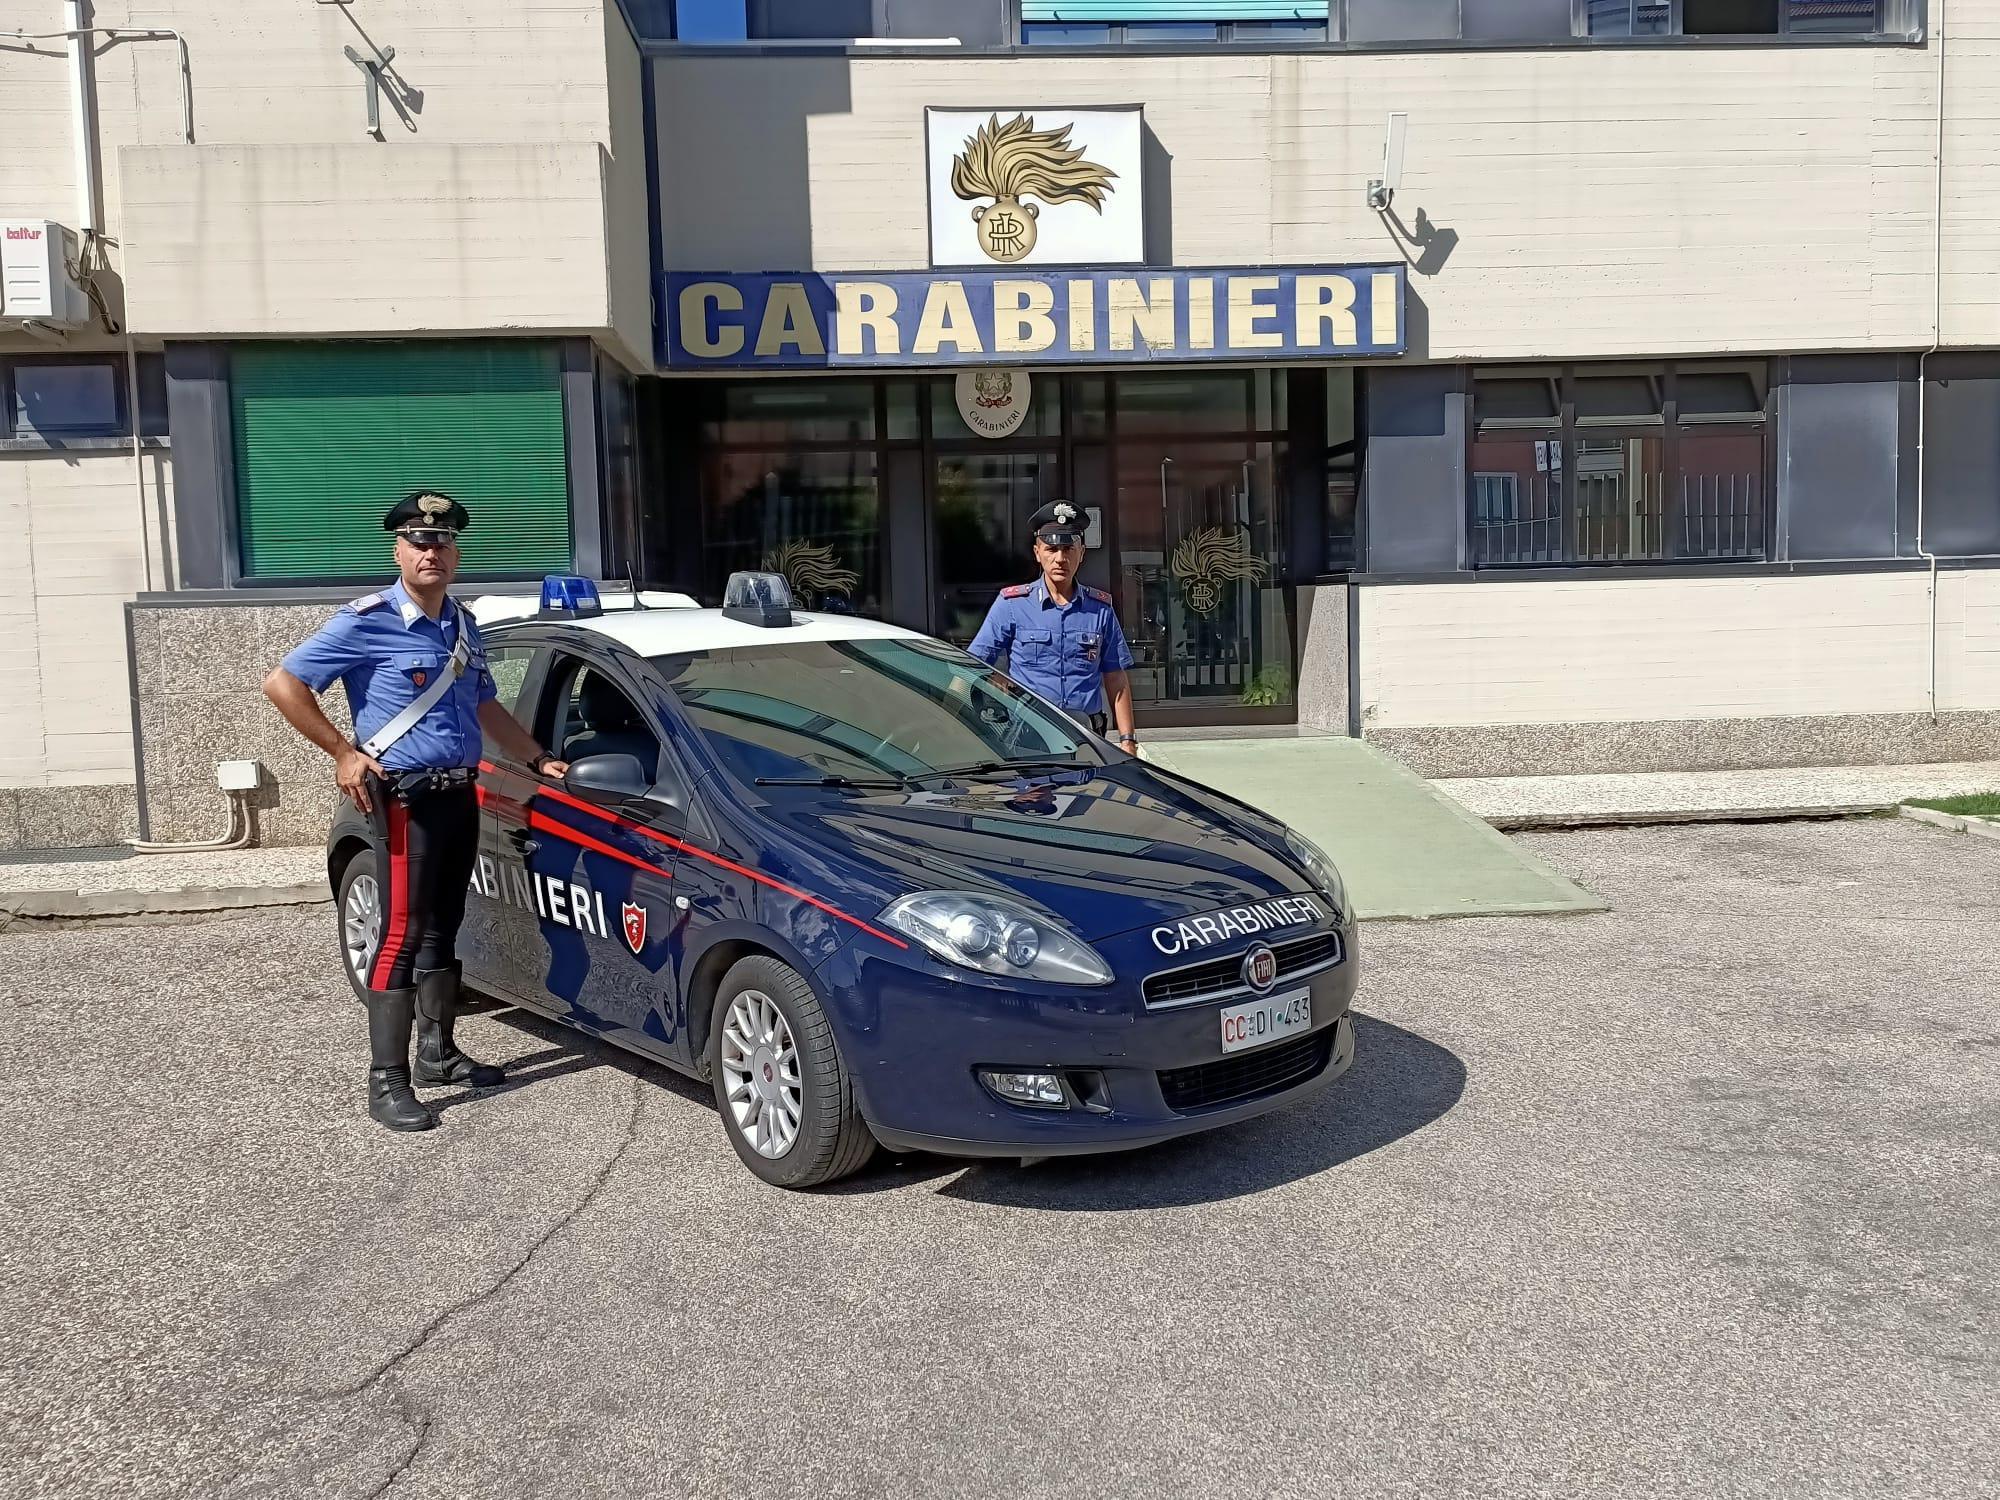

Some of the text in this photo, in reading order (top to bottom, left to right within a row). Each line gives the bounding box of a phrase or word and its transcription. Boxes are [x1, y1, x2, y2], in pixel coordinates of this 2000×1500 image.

[679, 272, 1398, 358] CARABINIERI
[969, 410, 1020, 431] CARABINIERI
[468, 854, 608, 939] ABINIERI
[1151, 896, 1325, 955] CARABINIERI
[1256, 959, 1271, 979] FIAT
